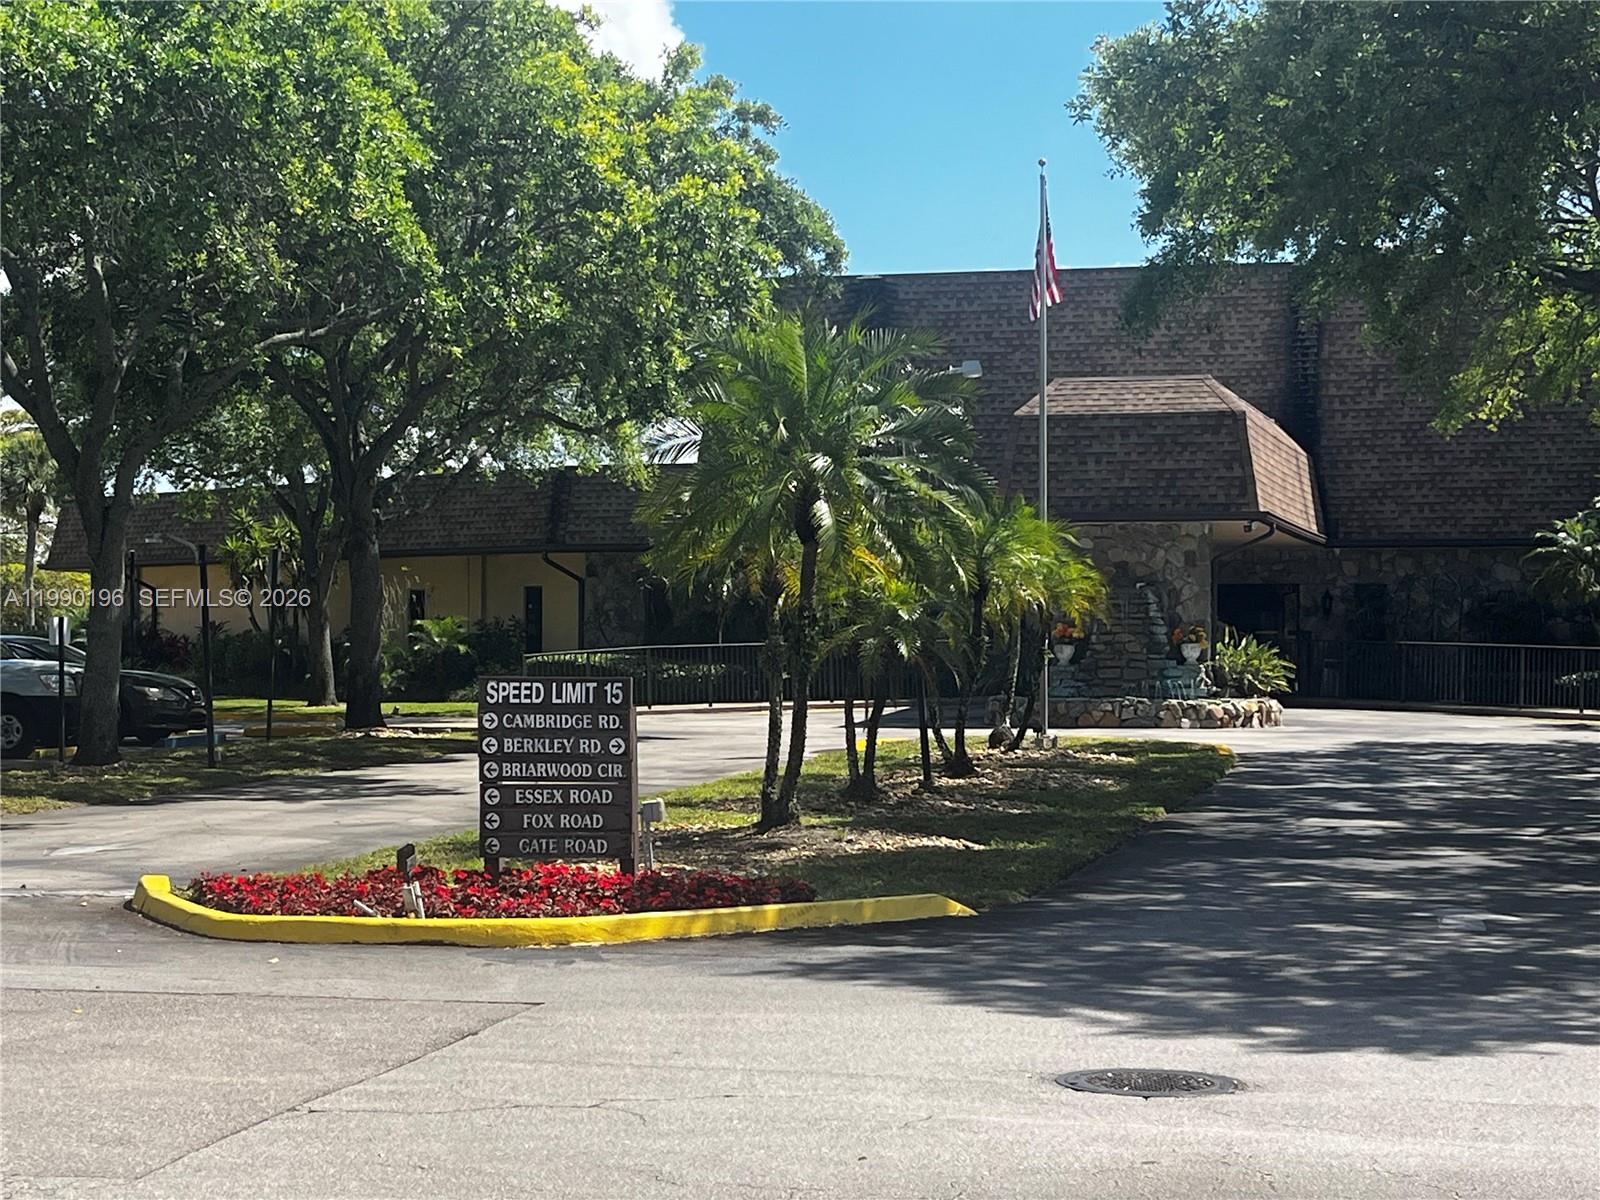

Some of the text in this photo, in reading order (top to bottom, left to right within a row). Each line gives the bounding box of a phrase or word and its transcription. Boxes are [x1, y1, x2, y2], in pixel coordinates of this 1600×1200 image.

[486, 681, 623, 704] SPEED LIMIT 15
[502, 713, 623, 729] CAMBRIDGE RD.
[503, 737, 605, 754] BERKLEY RD.
[502, 763, 626, 778] BRIARWOOD CIR.
[515, 789, 613, 804] ESSEX ROAD
[523, 814, 603, 829] FOX ROAD
[519, 838, 608, 854] GATE ROAD
